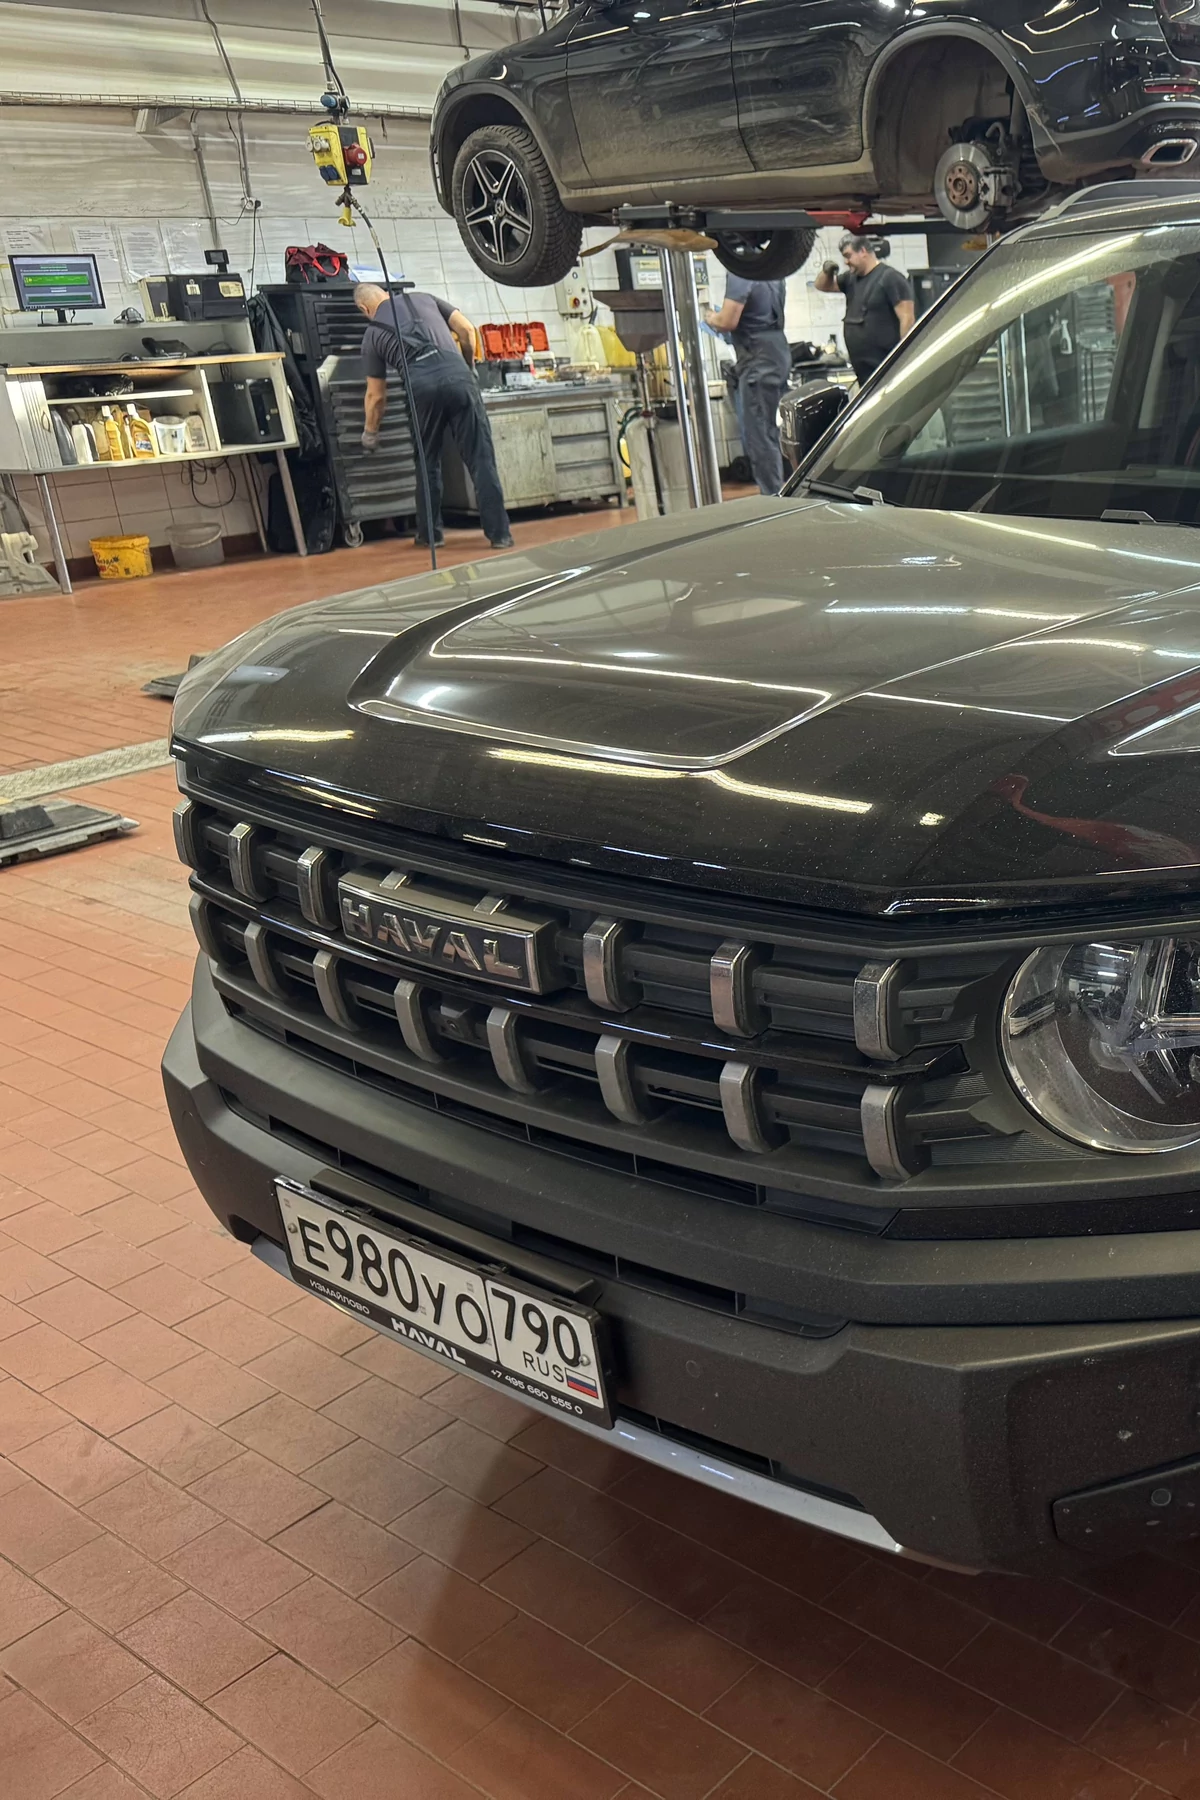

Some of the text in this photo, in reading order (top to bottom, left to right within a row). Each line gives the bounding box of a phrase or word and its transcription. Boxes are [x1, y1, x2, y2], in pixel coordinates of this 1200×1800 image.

[342, 897, 523, 979] HAVAL
[309, 1279, 371, 1315] ИЗМАЙЛОВО
[390, 1317, 467, 1365] HAVAL
[491, 1287, 581, 1368] 790
[522, 1351, 565, 1383] RUS
[490, 1368, 584, 1415] +7 495 660 555 0
